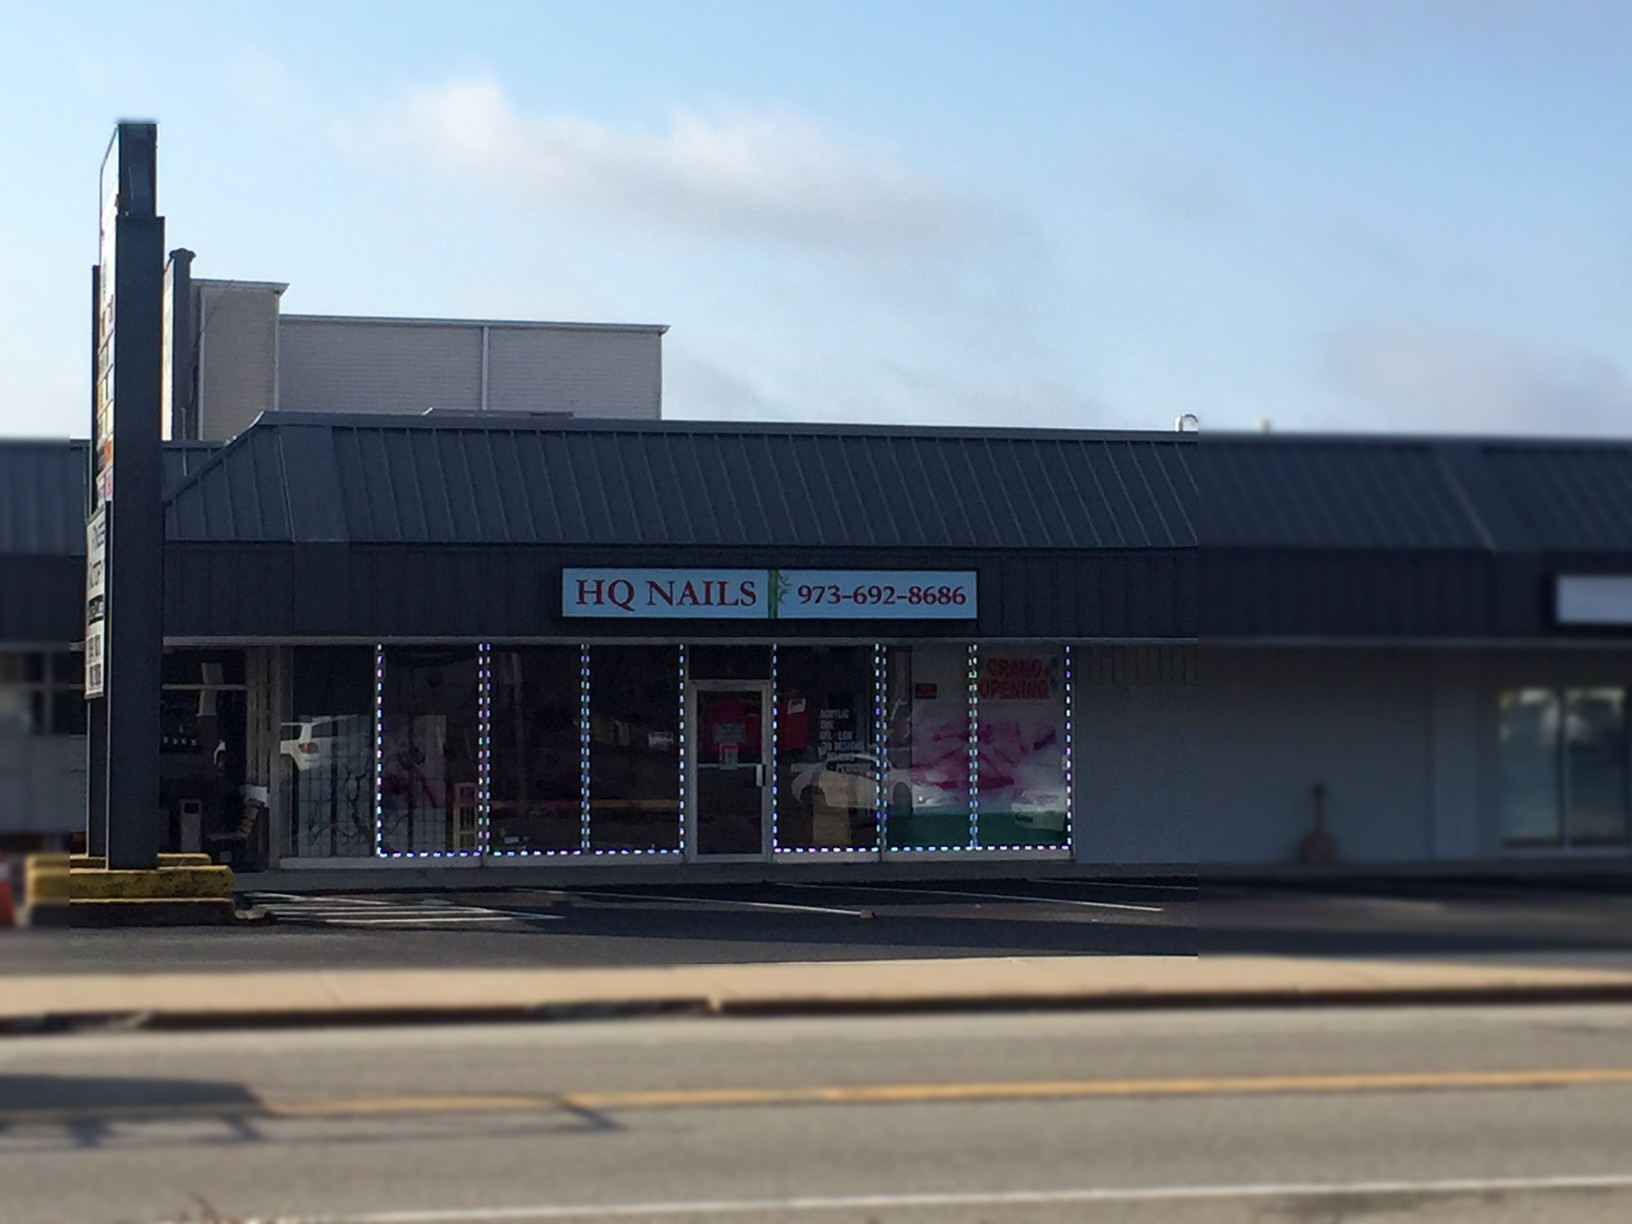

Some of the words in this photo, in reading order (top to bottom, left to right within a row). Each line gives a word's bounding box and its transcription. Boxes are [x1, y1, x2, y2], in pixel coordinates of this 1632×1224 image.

[576, 579, 634, 611] HQ
[646, 580, 757, 606] NAILS
[797, 584, 966, 605] 973-692-8686
[978, 677, 1049, 699] OPENING
